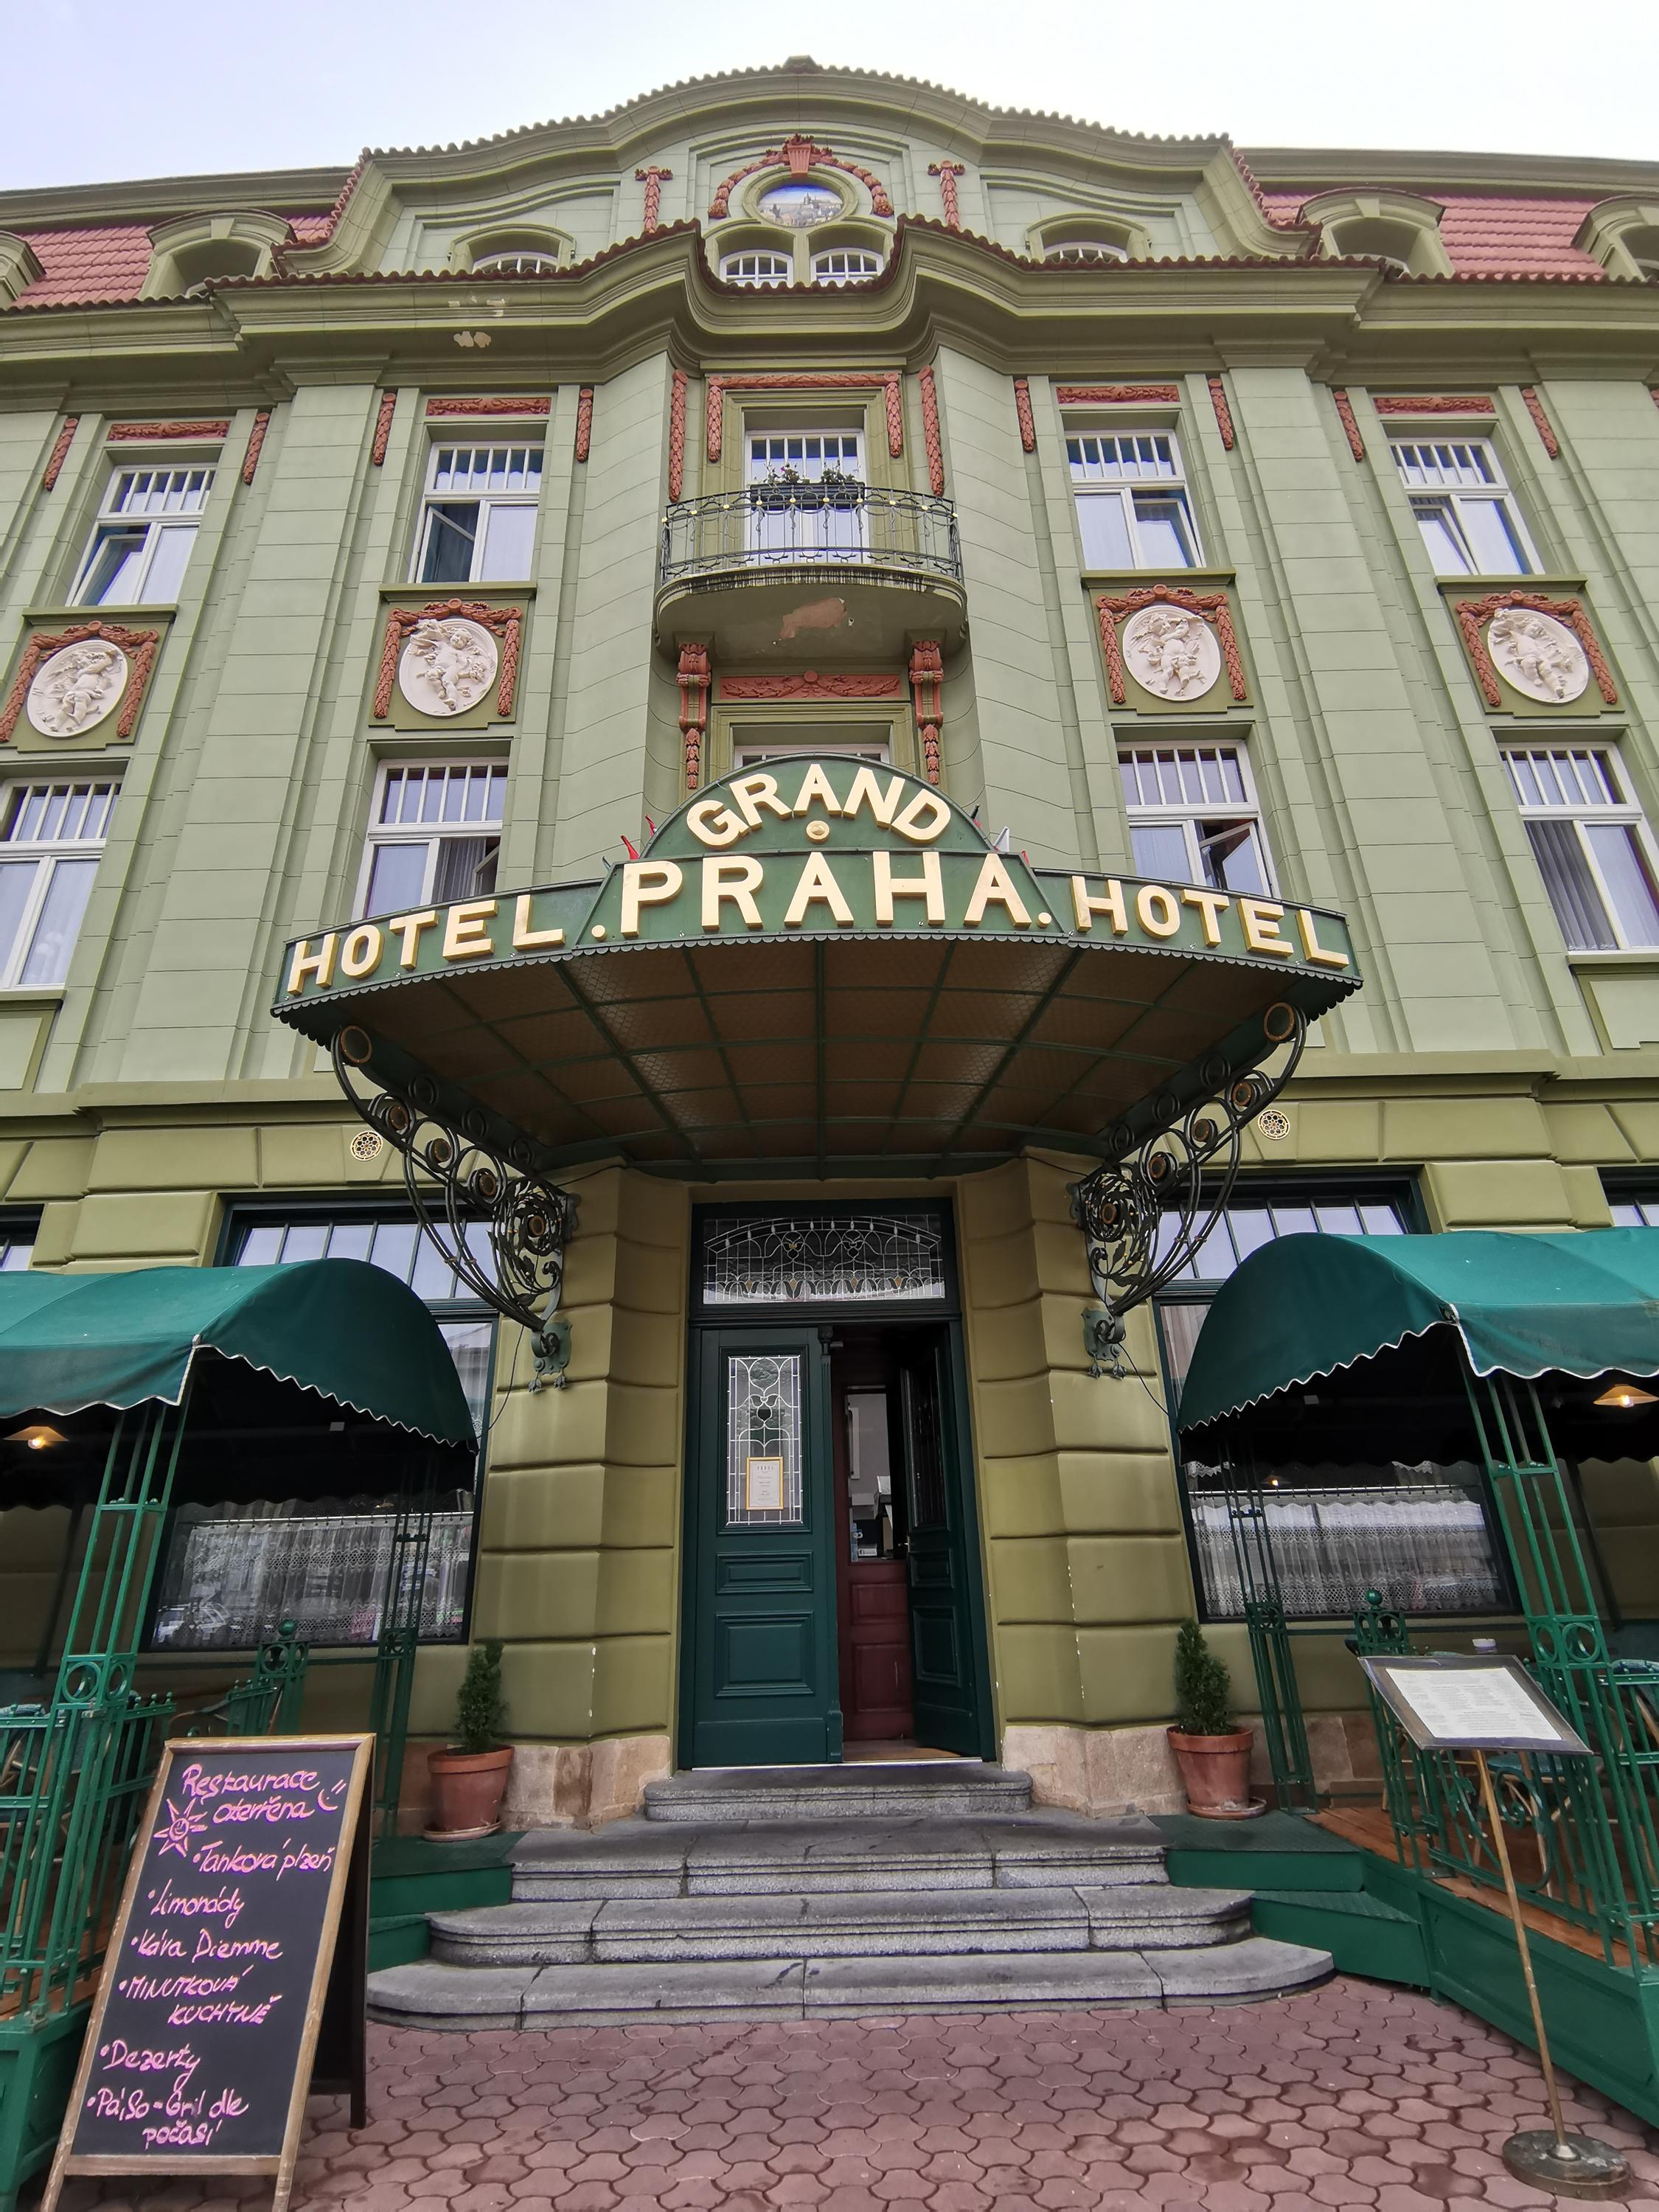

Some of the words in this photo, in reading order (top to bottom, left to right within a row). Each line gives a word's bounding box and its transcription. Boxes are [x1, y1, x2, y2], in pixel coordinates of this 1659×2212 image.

[686, 763, 951, 849] GRAND
[287, 894, 566, 995] HOTEL
[1071, 875, 1349, 969] HOTEL
[182, 1763, 321, 1804] Restaurace
[150, 1879, 245, 1929] Limonády
[138, 1929, 187, 1957] Káva
[102, 2039, 201, 2092] Dezerty
[209, 2087, 249, 2118] dle
[142, 2118, 224, 2151] počasí
